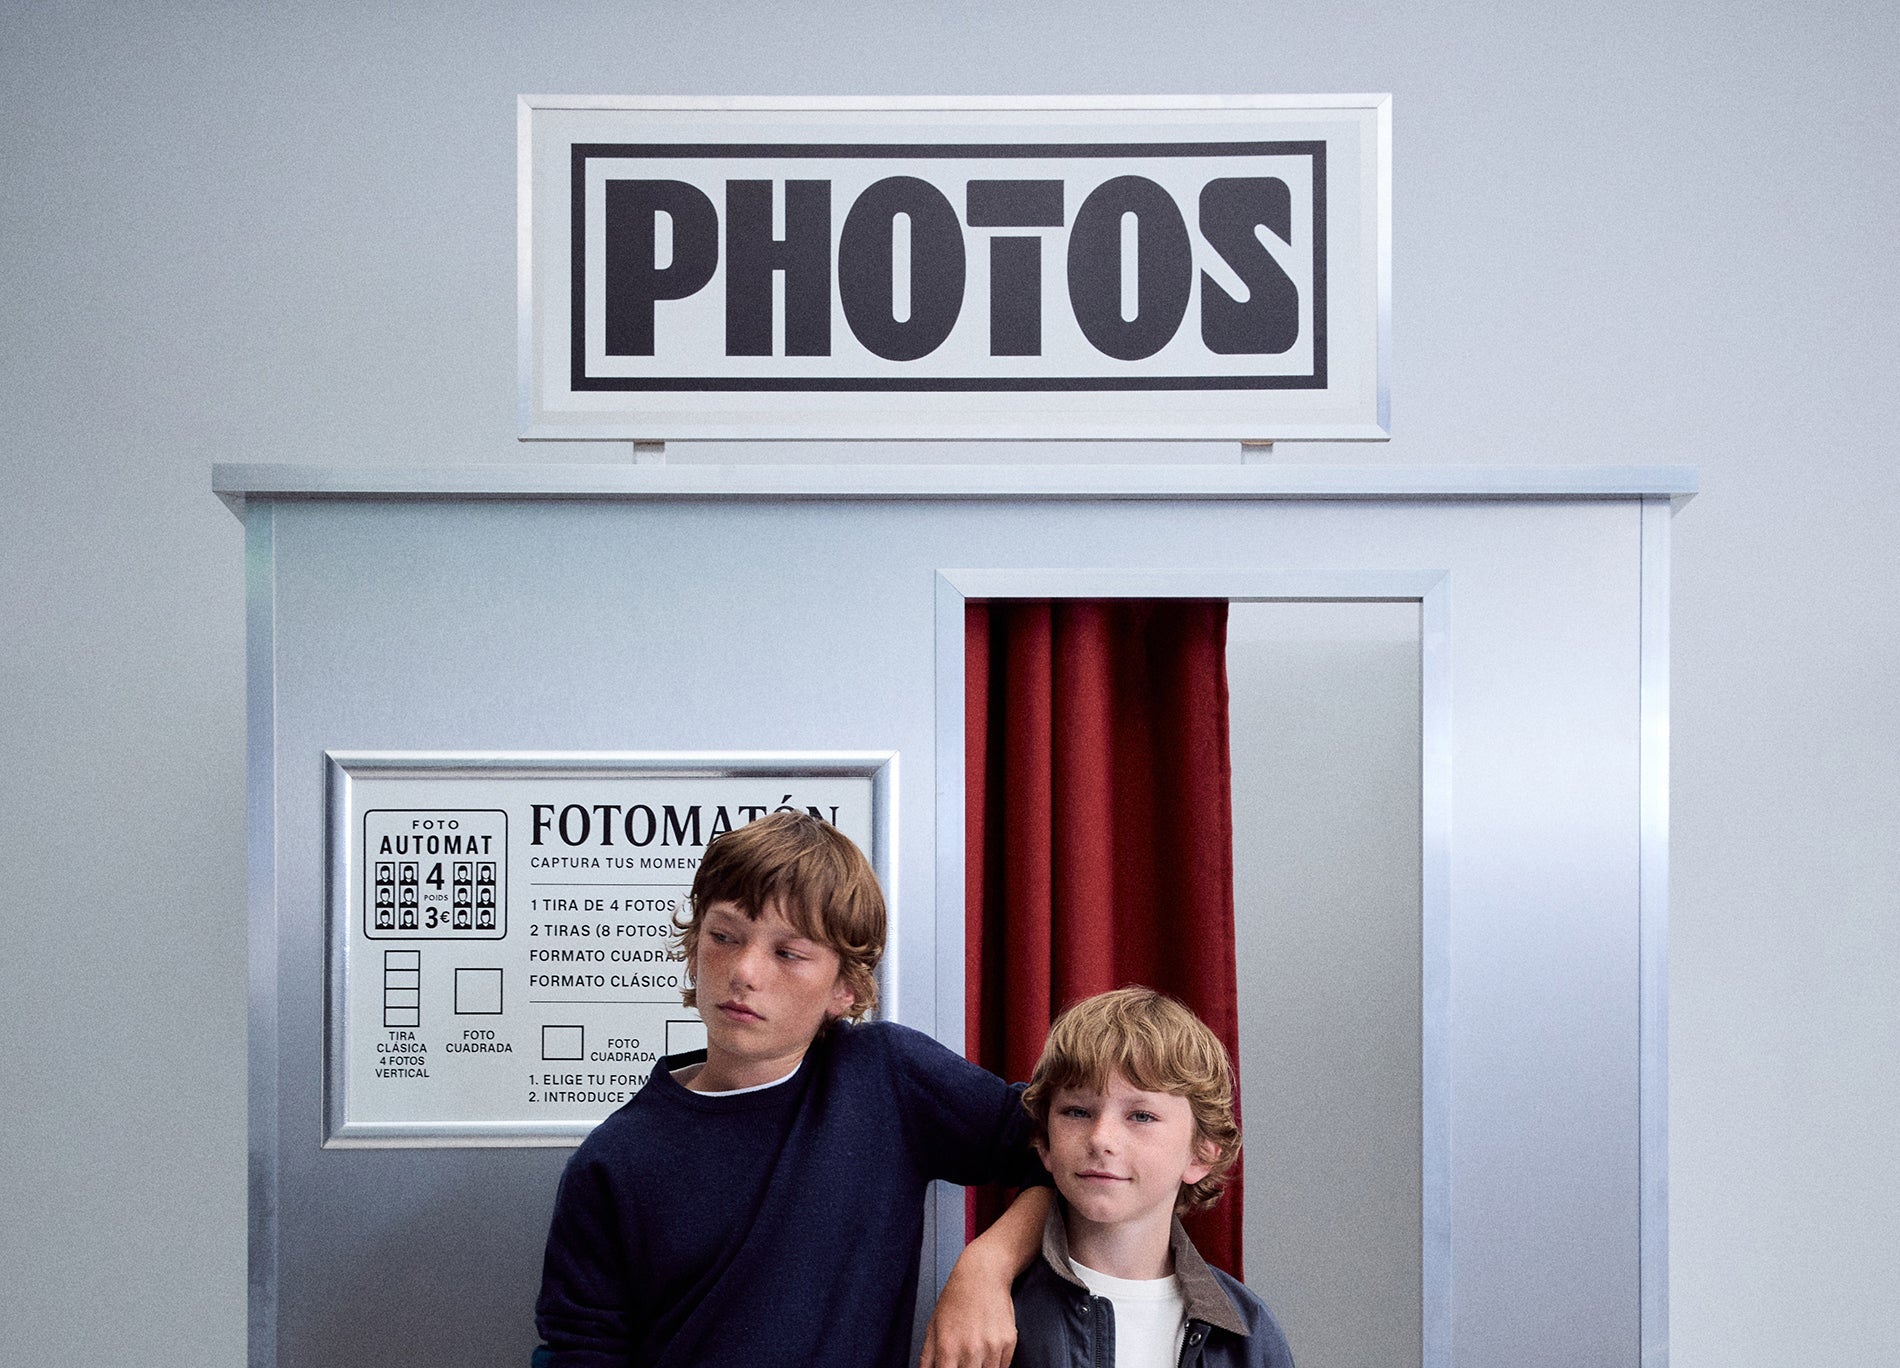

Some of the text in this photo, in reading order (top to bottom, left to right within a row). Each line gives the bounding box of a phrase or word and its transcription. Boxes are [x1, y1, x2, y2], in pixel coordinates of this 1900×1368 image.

[605, 175, 1299, 361] PHOTOS
[412, 820, 459, 830] FOTO
[380, 835, 492, 855] AUTOMAT
[530, 857, 600, 869] CAPTURA
[606, 858, 634, 869] TUS
[426, 862, 445, 890] 4
[424, 894, 449, 902] POIDS
[531, 900, 537, 911] 1
[543, 899, 578, 911] TIRA
[585, 900, 604, 911] DE
[610, 900, 620, 911] 4
[626, 899, 676, 912] FOTOS
[425, 906, 450, 929] 3€
[530, 924, 673, 939] 2 TIRAS (8 FOTOS)
[530, 949, 605, 962] FORMATO
[530, 972, 678, 987] FORMATO CLÁSICO
[389, 1031, 415, 1041] TIRA
[463, 1030, 495, 1040] FOTO
[376, 1041, 427, 1053] CLÁSICA
[445, 1043, 513, 1053] CUADRADA
[608, 1039, 639, 1049] FOTO
[379, 1056, 425, 1066] 4 FOTOS
[590, 1052, 657, 1062] CUADRADA
[375, 1069, 430, 1079] VERTICAL
[529, 1075, 539, 1085] 1.
[544, 1075, 583, 1085] ELIGE
[588, 1075, 605, 1085] TU
[529, 1092, 540, 1103] 2.
[544, 1092, 625, 1103] INTRODUCE
